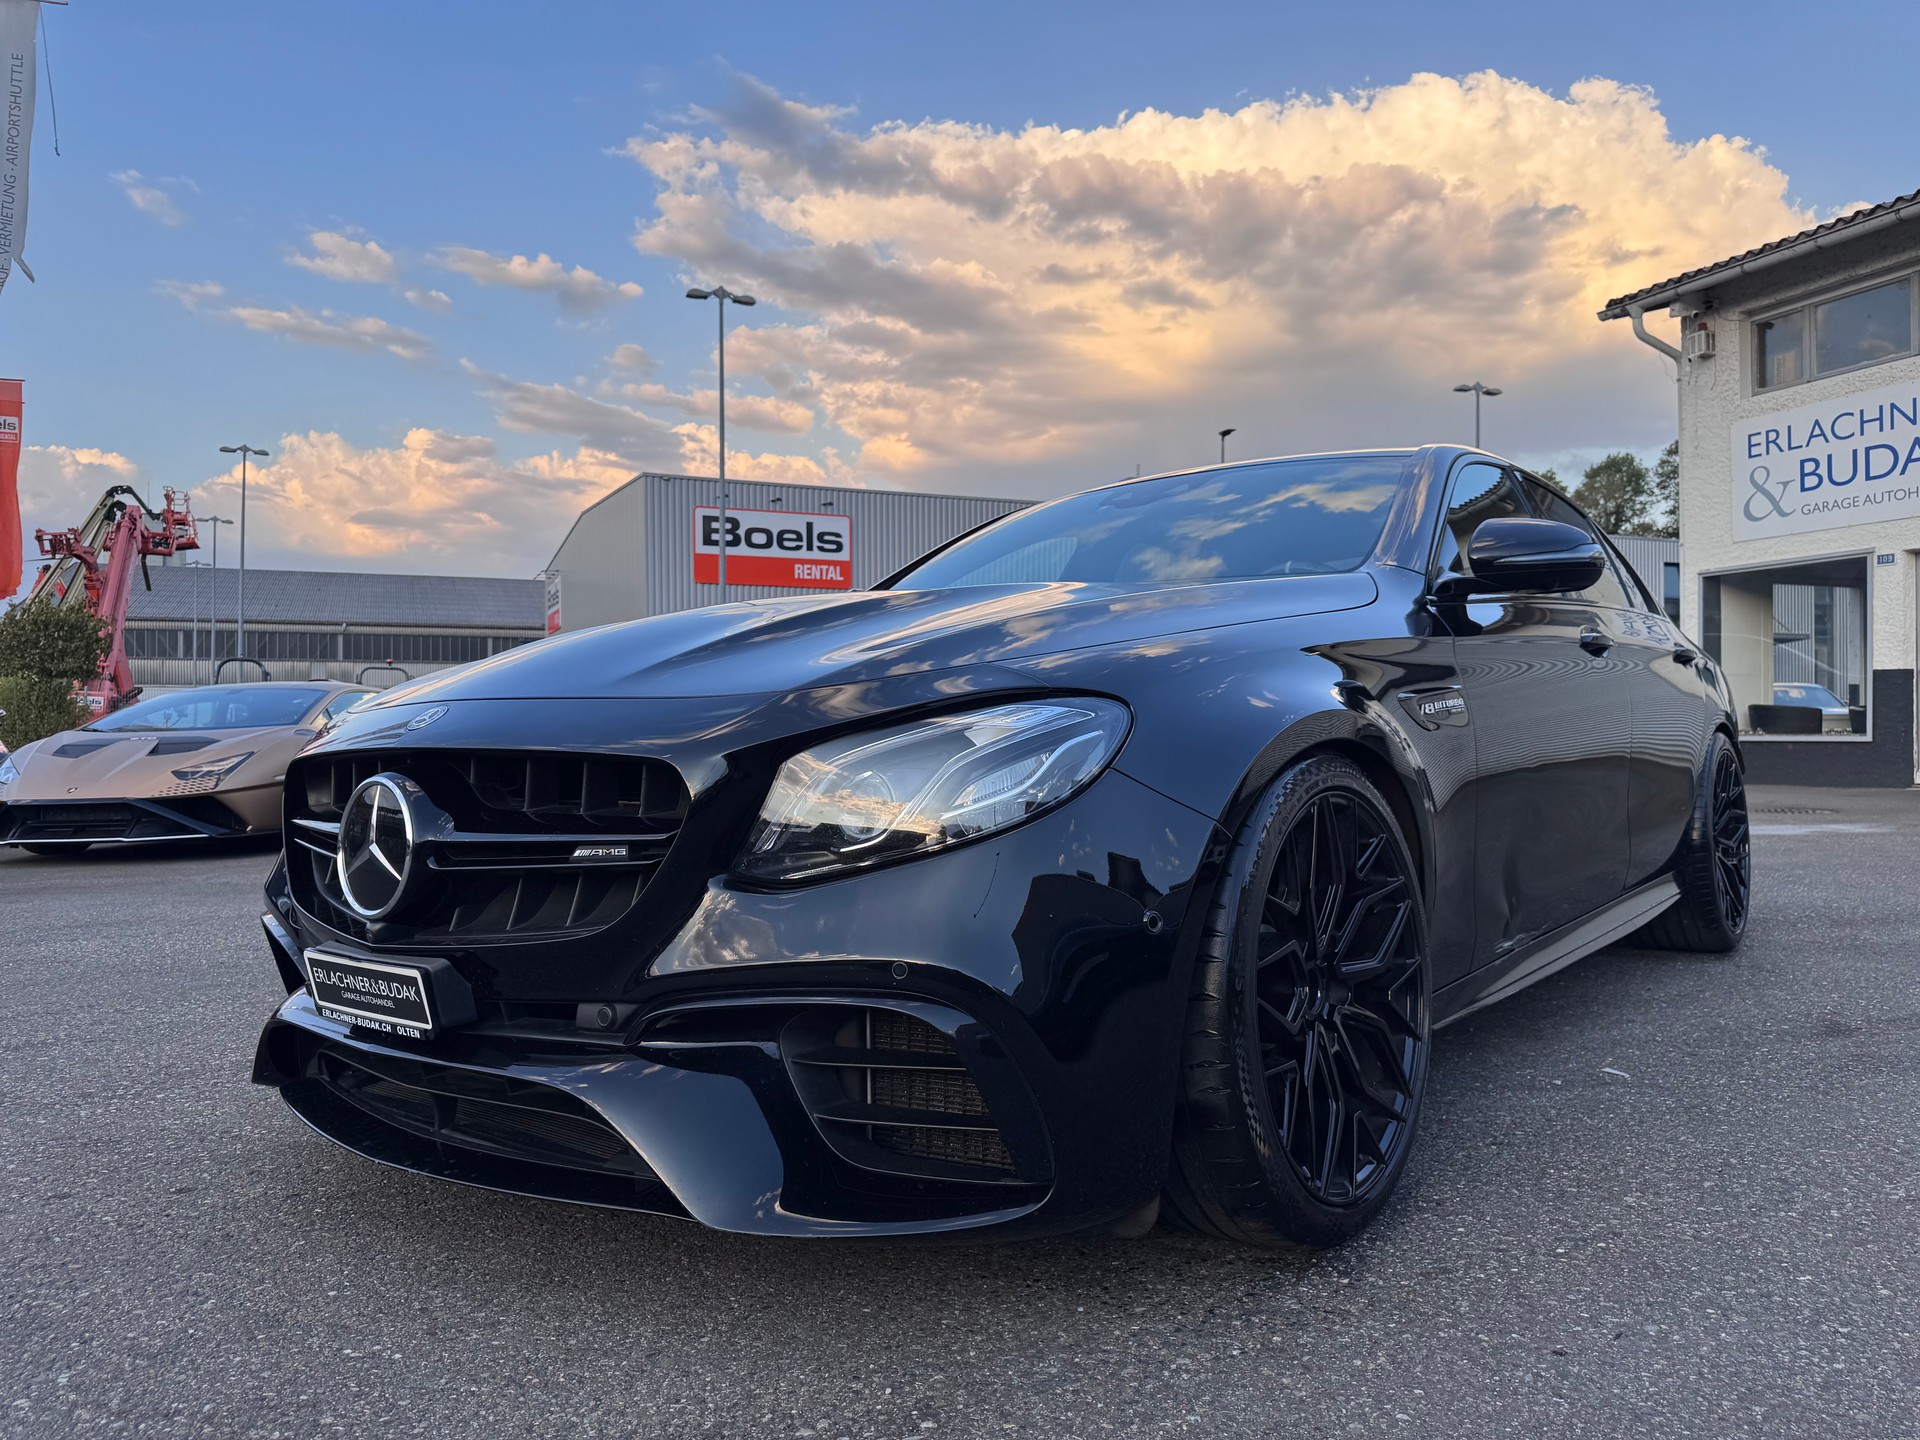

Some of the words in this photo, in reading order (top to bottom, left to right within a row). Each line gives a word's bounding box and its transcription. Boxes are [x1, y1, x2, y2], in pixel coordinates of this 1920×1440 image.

[5, 52, 24, 167] AIRPORTSHUTTLE
[0, 174, 17, 256] VERMIETUNG
[1747, 397, 1918, 460] ERLACHN
[1743, 465, 1797, 522] &
[1799, 436, 1920, 493] BUDA
[1800, 495, 1861, 516] GARAGE
[1862, 486, 1920, 508] AUTOH
[702, 515, 844, 554] Boels
[794, 563, 845, 581] RENTAL
[1879, 554, 1893, 564] 109
[1434, 698, 1464, 709] BITURBO
[590, 848, 627, 857] AMG
[341, 990, 361, 1002] GARAGE
[360, 995, 396, 1009] AUTOHANDEL
[322, 1008, 392, 1033] ERLACHNER-BUDAK.CH
[396, 1025, 421, 1039] OLTEN
